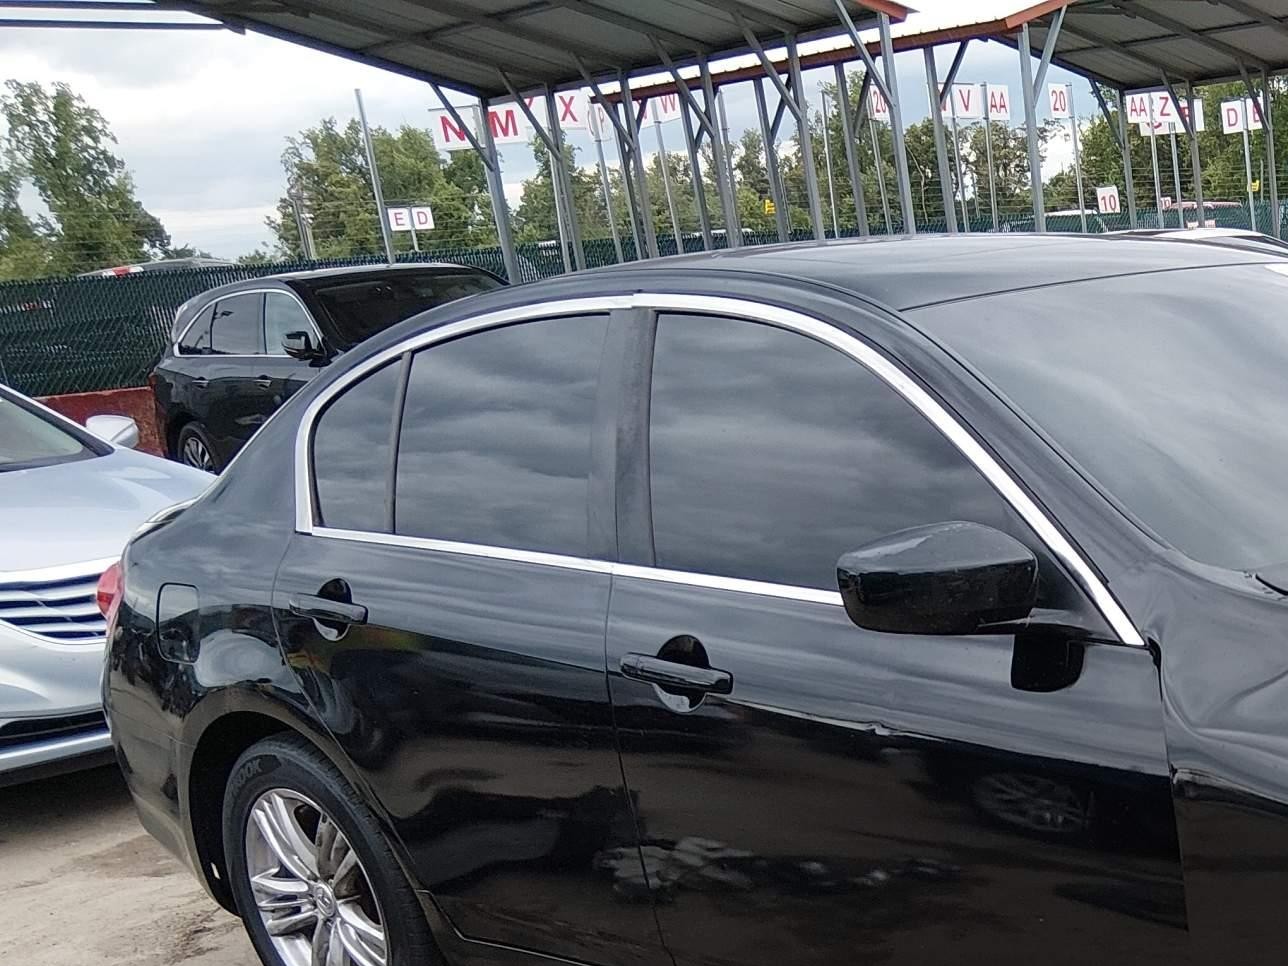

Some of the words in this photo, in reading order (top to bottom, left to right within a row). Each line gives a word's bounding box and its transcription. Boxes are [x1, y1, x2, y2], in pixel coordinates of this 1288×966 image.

[558, 95, 579, 122] X
[958, 89, 971, 112] V
[989, 91, 1008, 113] AA
[1051, 90, 1067, 112] 20
[1129, 96, 1148, 118] AA
[1159, 96, 1171, 117] Z
[488, 109, 519, 138] M
[1226, 108, 1238, 127] D
[1101, 194, 1117, 212] 10
[393, 212, 405, 226] E
[416, 211, 429, 225] D
